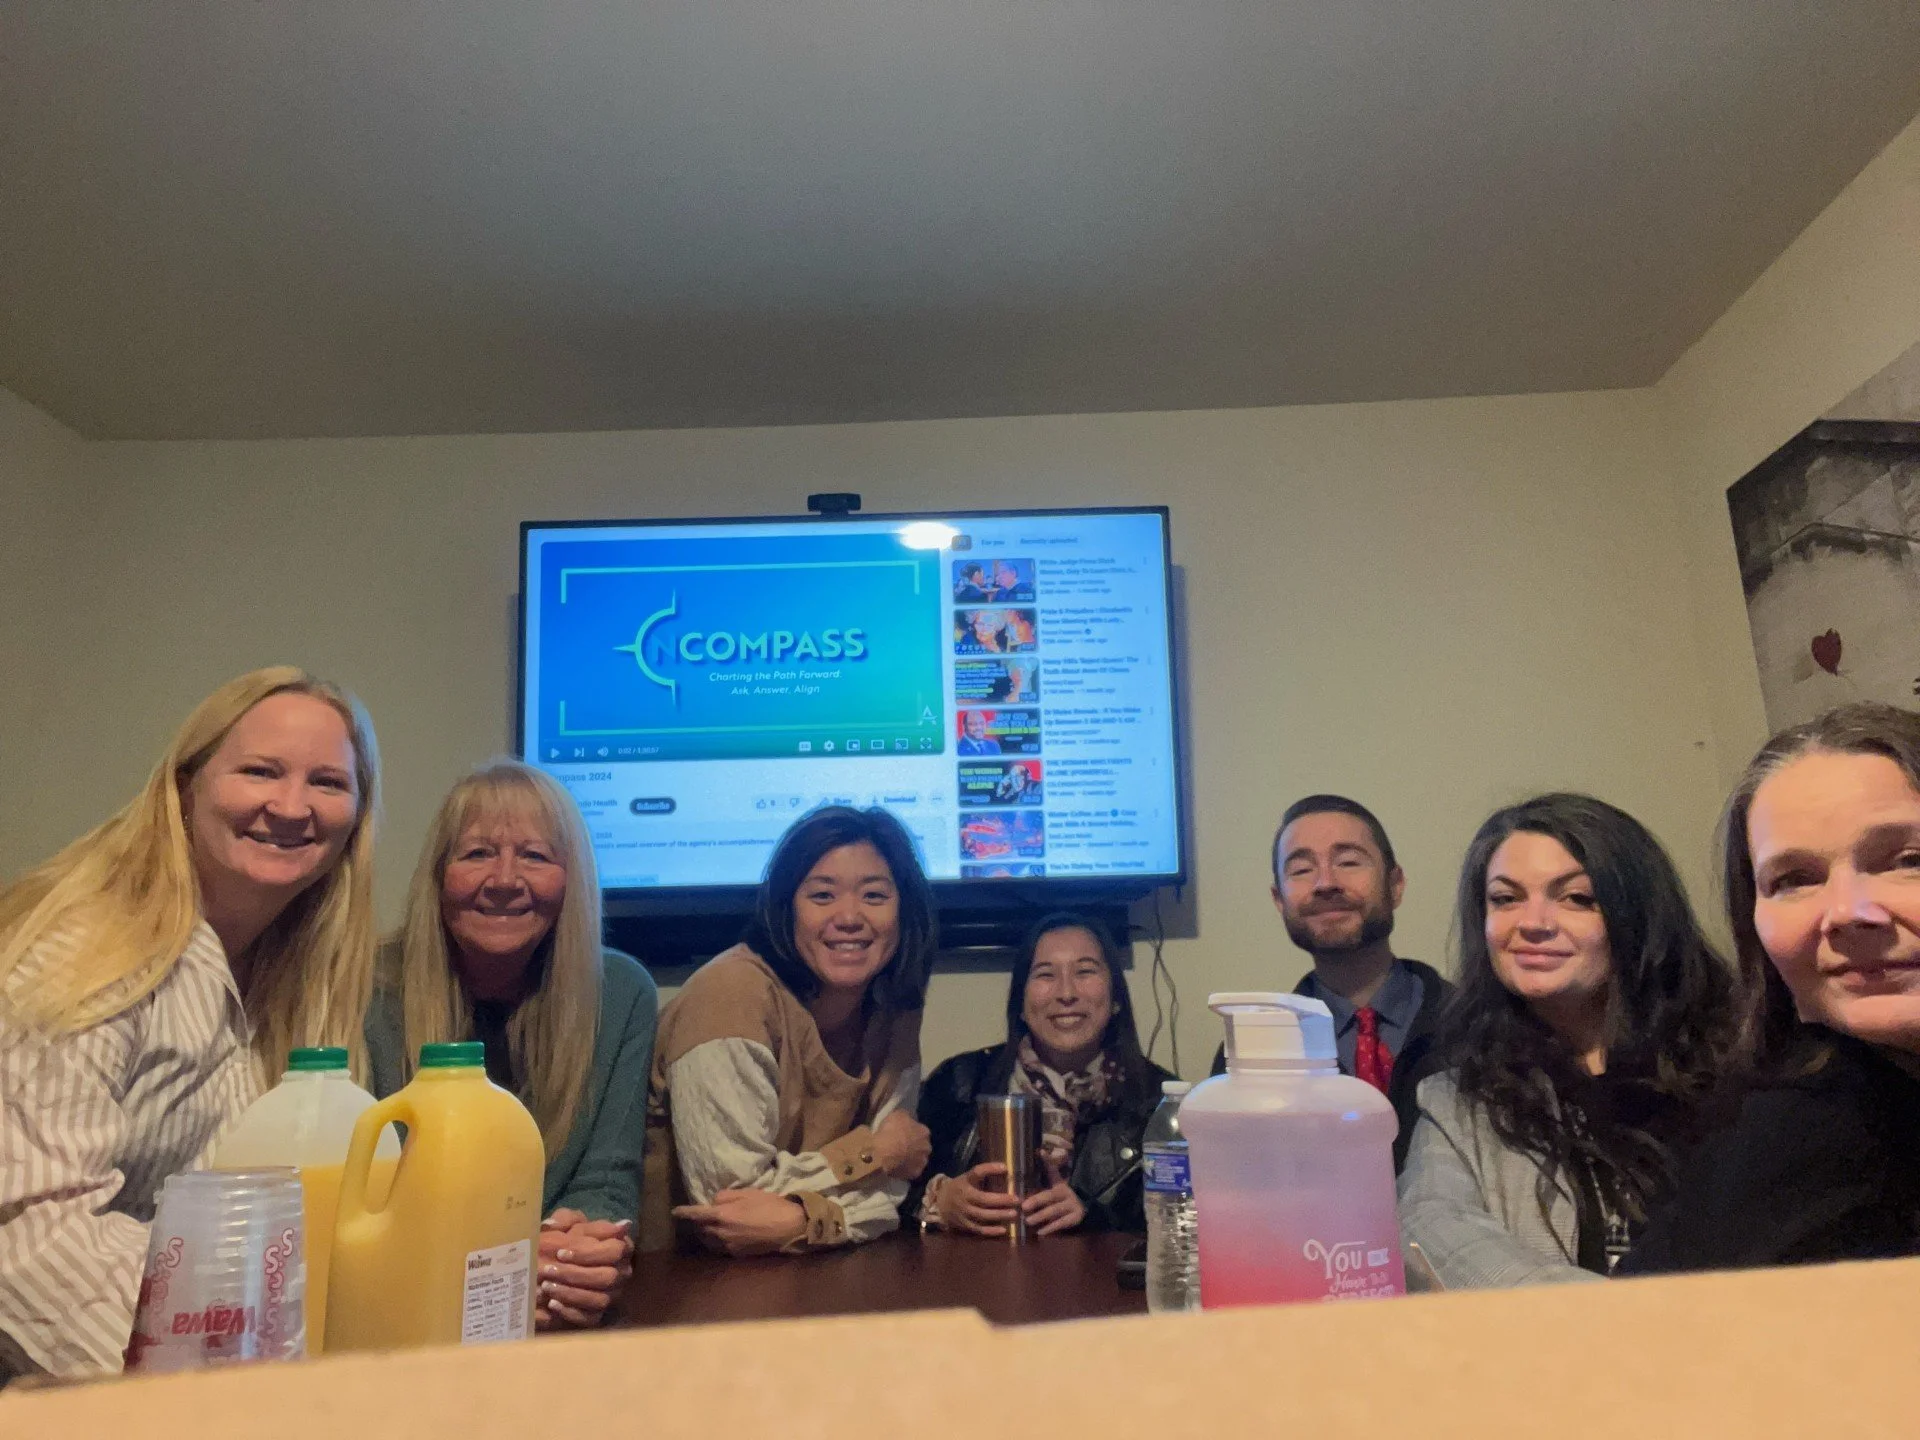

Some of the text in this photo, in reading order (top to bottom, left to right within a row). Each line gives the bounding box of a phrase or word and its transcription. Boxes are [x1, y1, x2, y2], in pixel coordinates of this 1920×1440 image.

[709, 672, 752, 682] Charting
[755, 671, 771, 680] the
[773, 670, 796, 680] Path
[794, 684, 820, 695] Align
[589, 772, 612, 781] 2024
[172, 1305, 256, 1335] Wawa
